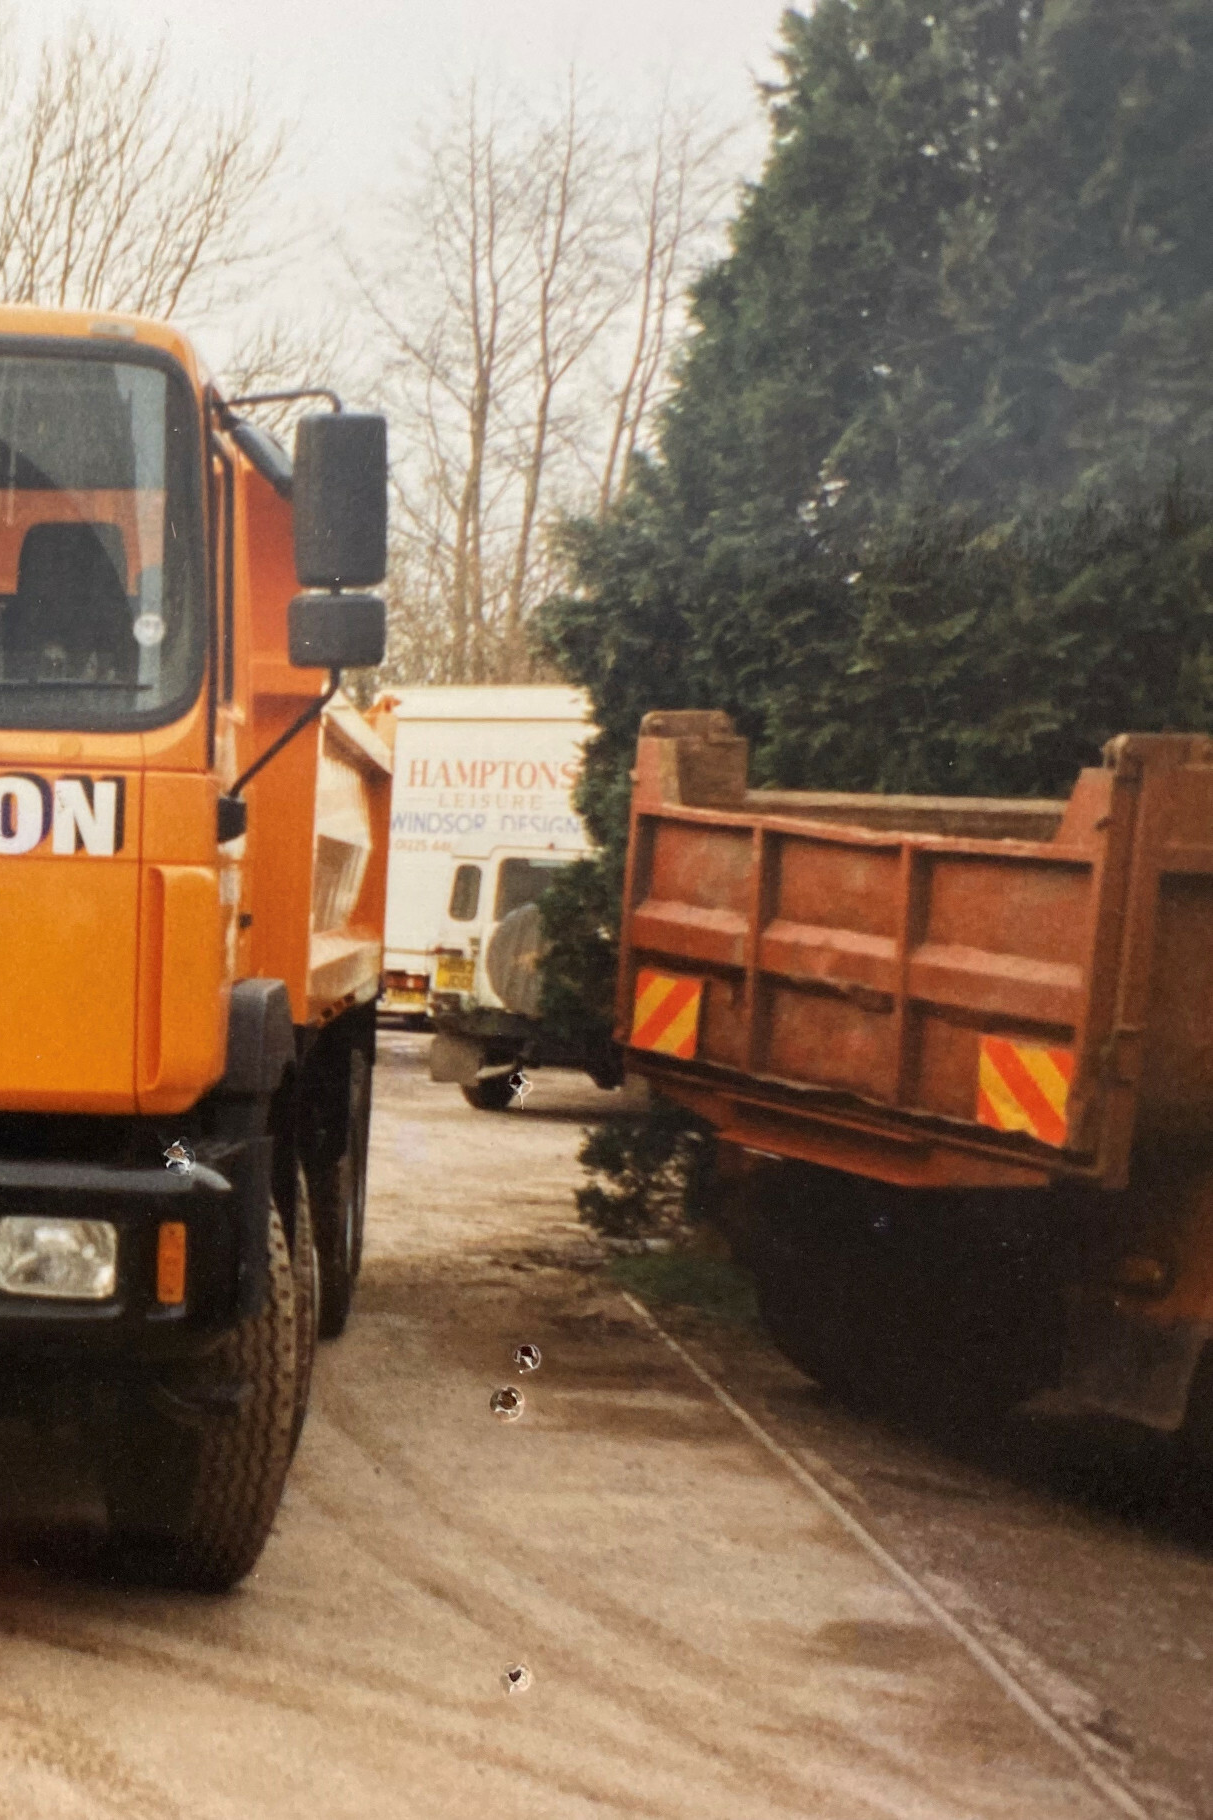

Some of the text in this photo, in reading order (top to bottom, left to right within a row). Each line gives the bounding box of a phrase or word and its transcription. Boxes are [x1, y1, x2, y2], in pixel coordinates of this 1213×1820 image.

[407, 760, 579, 790] HAMPTONS
[438, 792, 544, 810] LEISURE
[391, 812, 485, 834] WINDSOR
